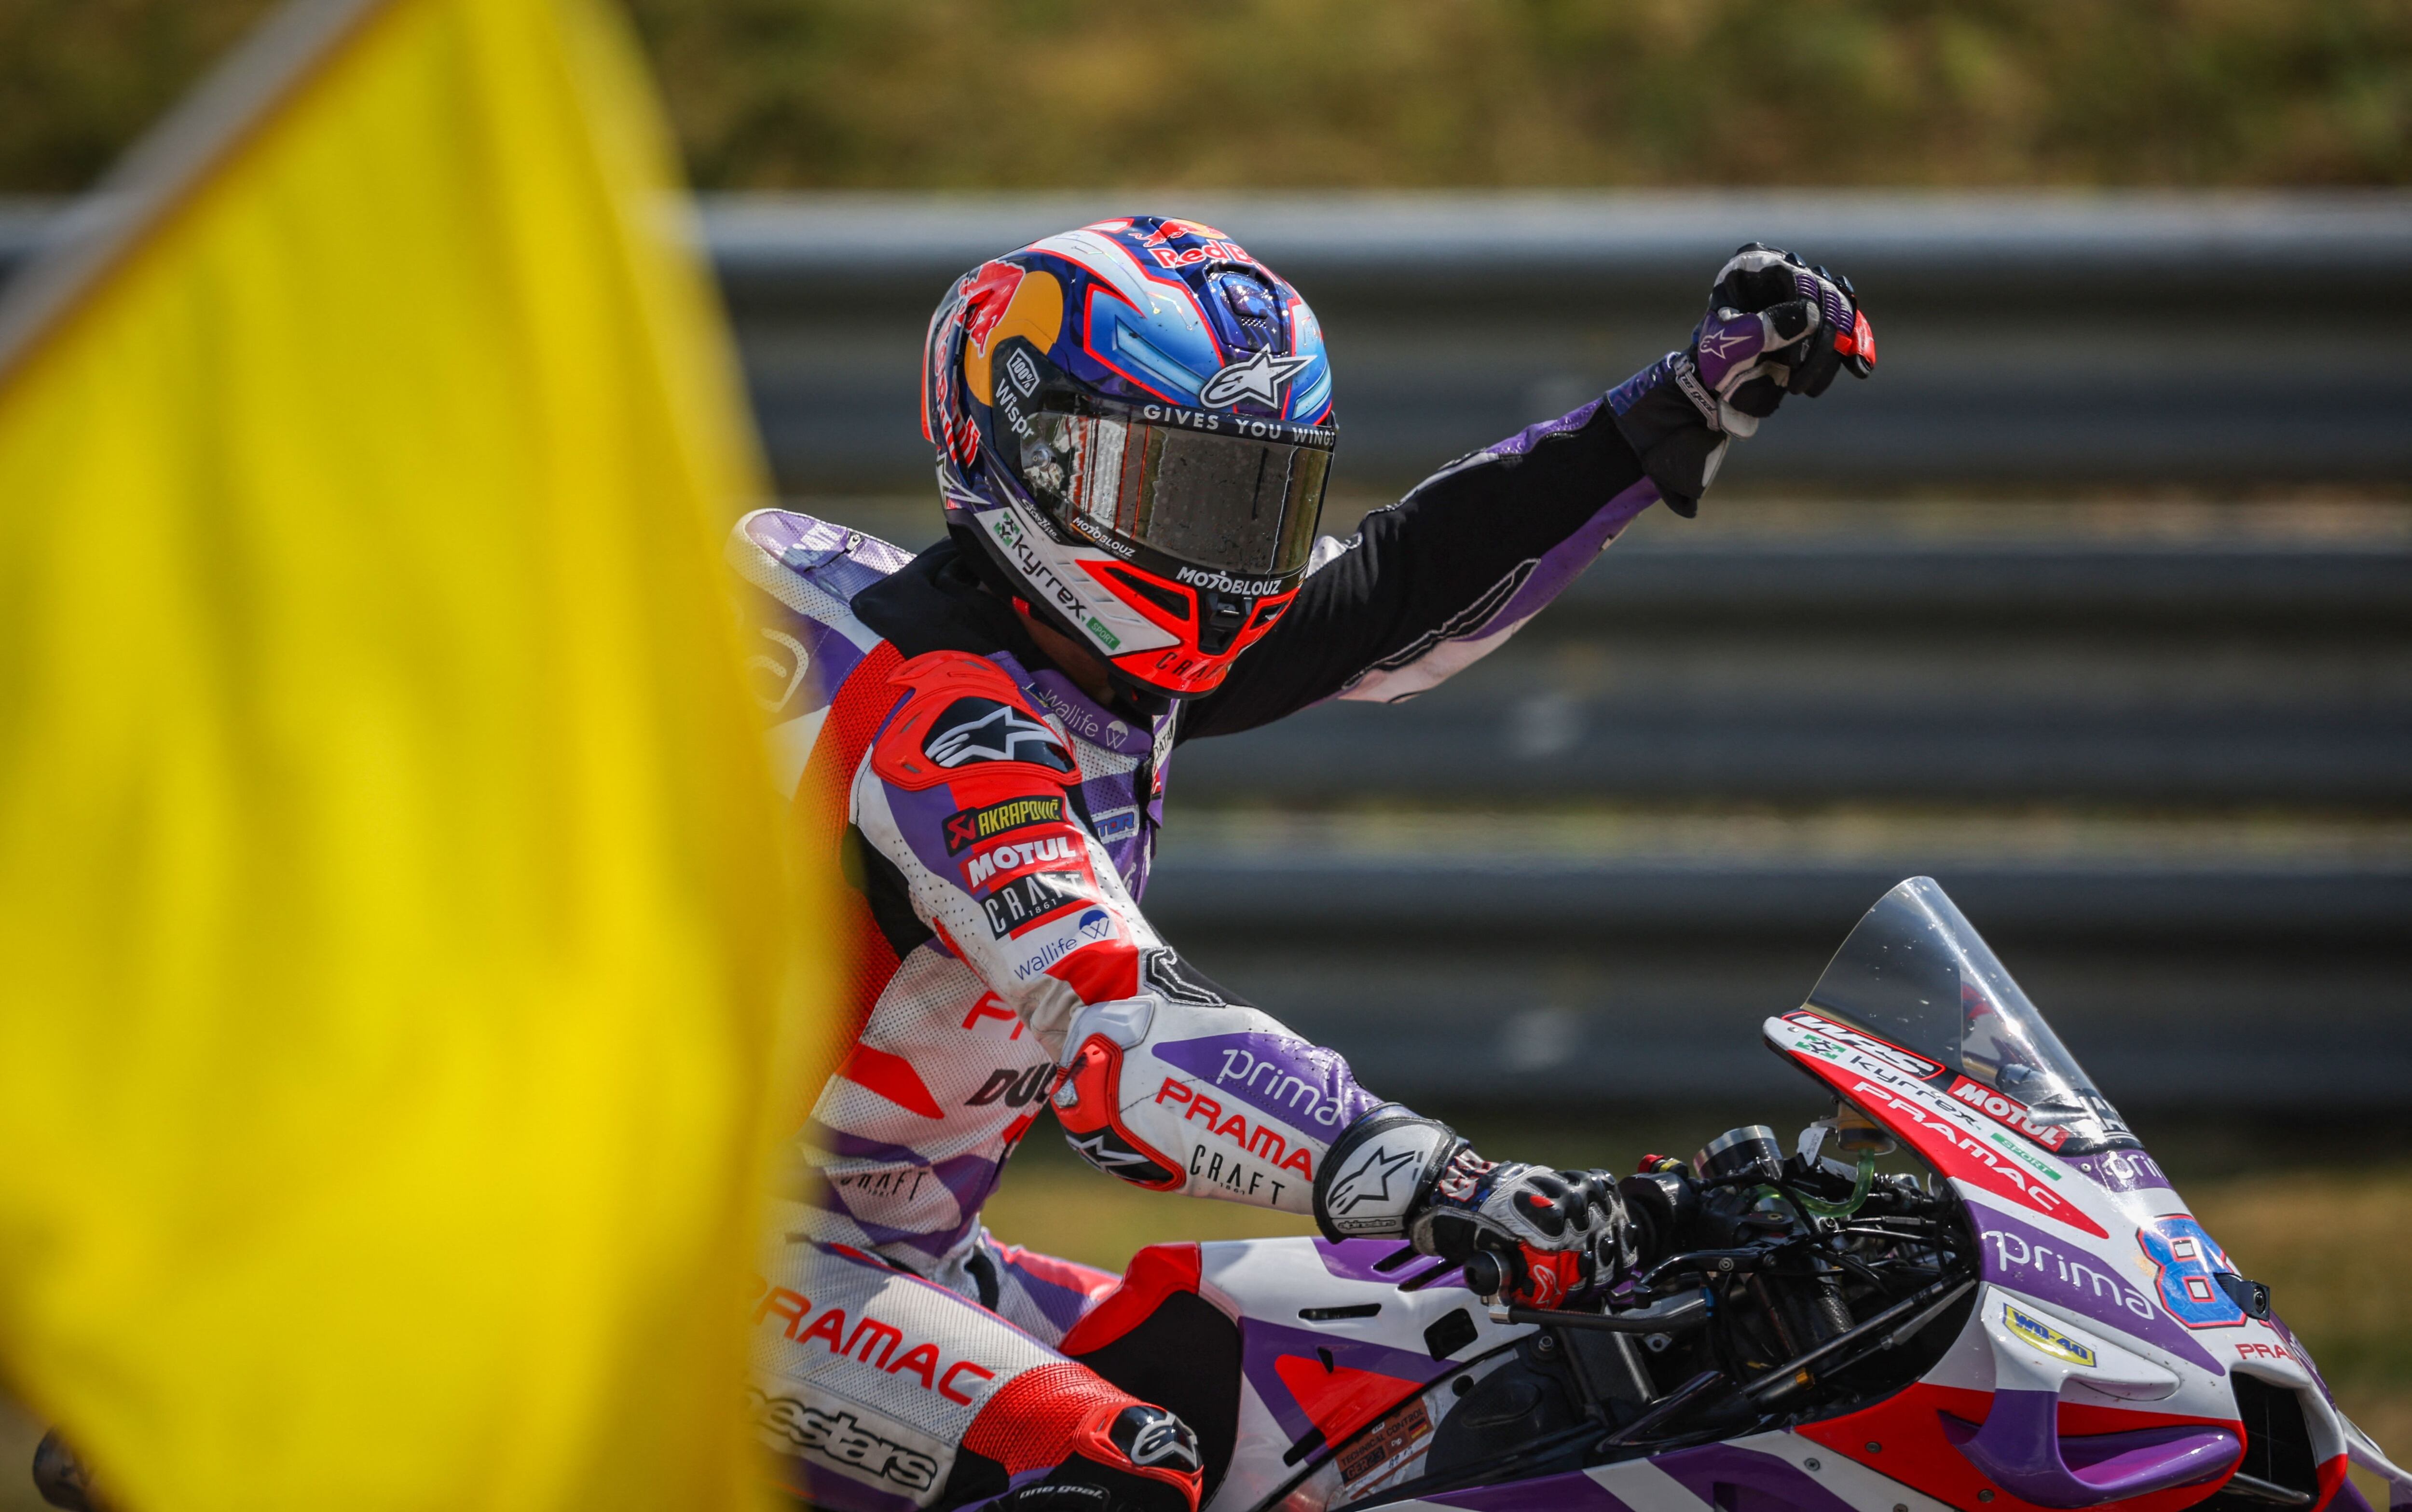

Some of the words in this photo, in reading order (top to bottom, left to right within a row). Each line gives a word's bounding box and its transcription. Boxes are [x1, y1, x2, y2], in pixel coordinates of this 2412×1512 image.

[1009, 356, 1032, 391] 100%
[995, 378, 1036, 439] Wispr
[1143, 405, 1219, 430] GIVES
[1235, 418, 1281, 439] YOU
[1292, 427, 1335, 447] WINGS
[1072, 517, 1136, 557] MOTOBLOUZ
[1012, 534, 1087, 620] kyrrex
[1176, 567, 1282, 596] MOTOBLOUZ
[1091, 621, 1116, 646] SPORT
[1042, 689, 1099, 738] wallife
[978, 799, 1060, 837] AKRAPOVIČ
[968, 837, 1077, 888] MOTUL
[986, 873, 1080, 934] CRAFT
[1028, 899, 1058, 917] 1861
[1014, 938, 1077, 981] wallife
[1216, 1049, 1343, 1126] prima
[1850, 1055, 1977, 1127] kyrrex
[1954, 1083, 2063, 1146] MOTUL
[1852, 1082, 2061, 1211] PRAMAC
[2001, 1140, 2053, 1175] SPORT
[1189, 1144, 1286, 1205] CRAFT
[1220, 1183, 1246, 1196] 1861
[1984, 1230, 2155, 1320] prima
[2012, 1310, 2088, 1360] WD-40
[1341, 1433, 1385, 1467] TECHNICAL
[1386, 1408, 1424, 1437] CONTROL
[1019, 1485, 1055, 1500] one
[1057, 1485, 1103, 1499] goal.
